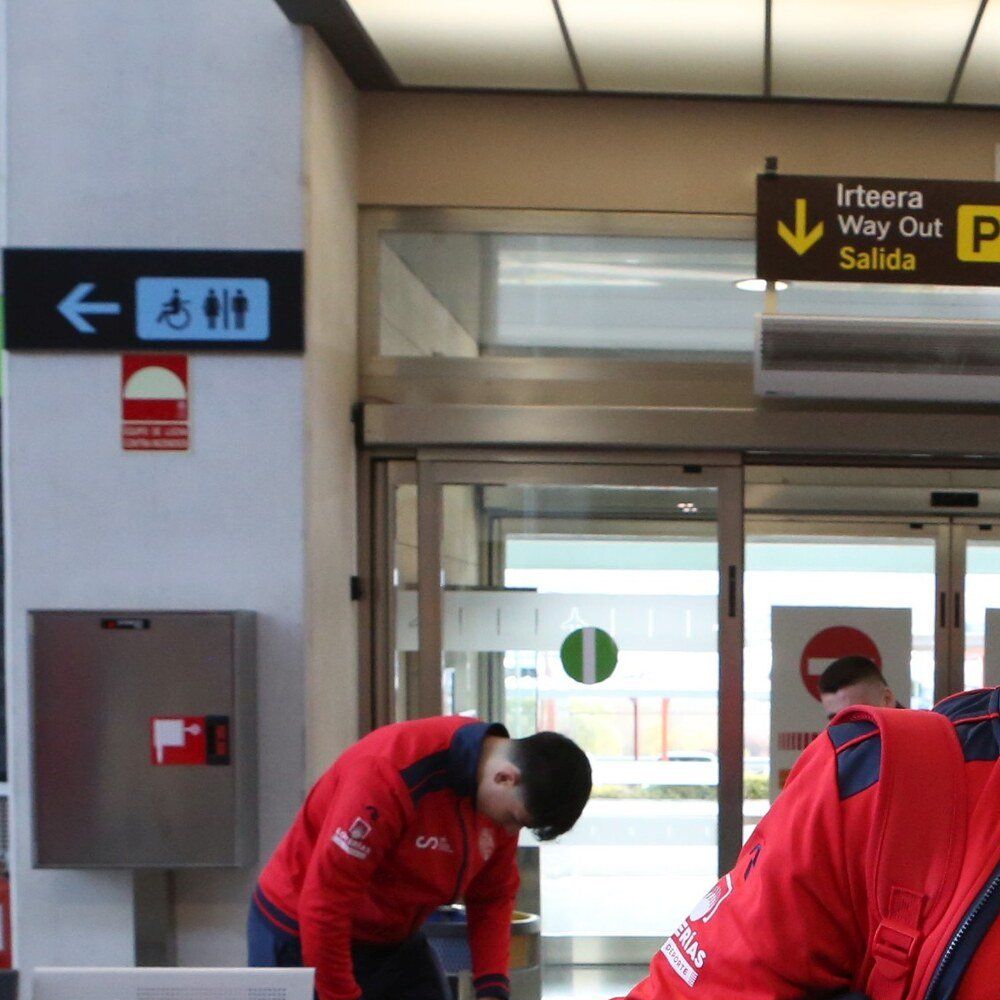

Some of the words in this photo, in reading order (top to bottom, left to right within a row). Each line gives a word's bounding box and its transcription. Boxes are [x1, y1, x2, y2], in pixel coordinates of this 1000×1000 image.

[837, 183, 923, 209] Irteera
[838, 214, 891, 241] Way
[899, 216, 943, 238] Out
[973, 215, 1000, 253] P
[840, 246, 917, 271] Salida
[665, 943, 690, 977] DEPORTE
